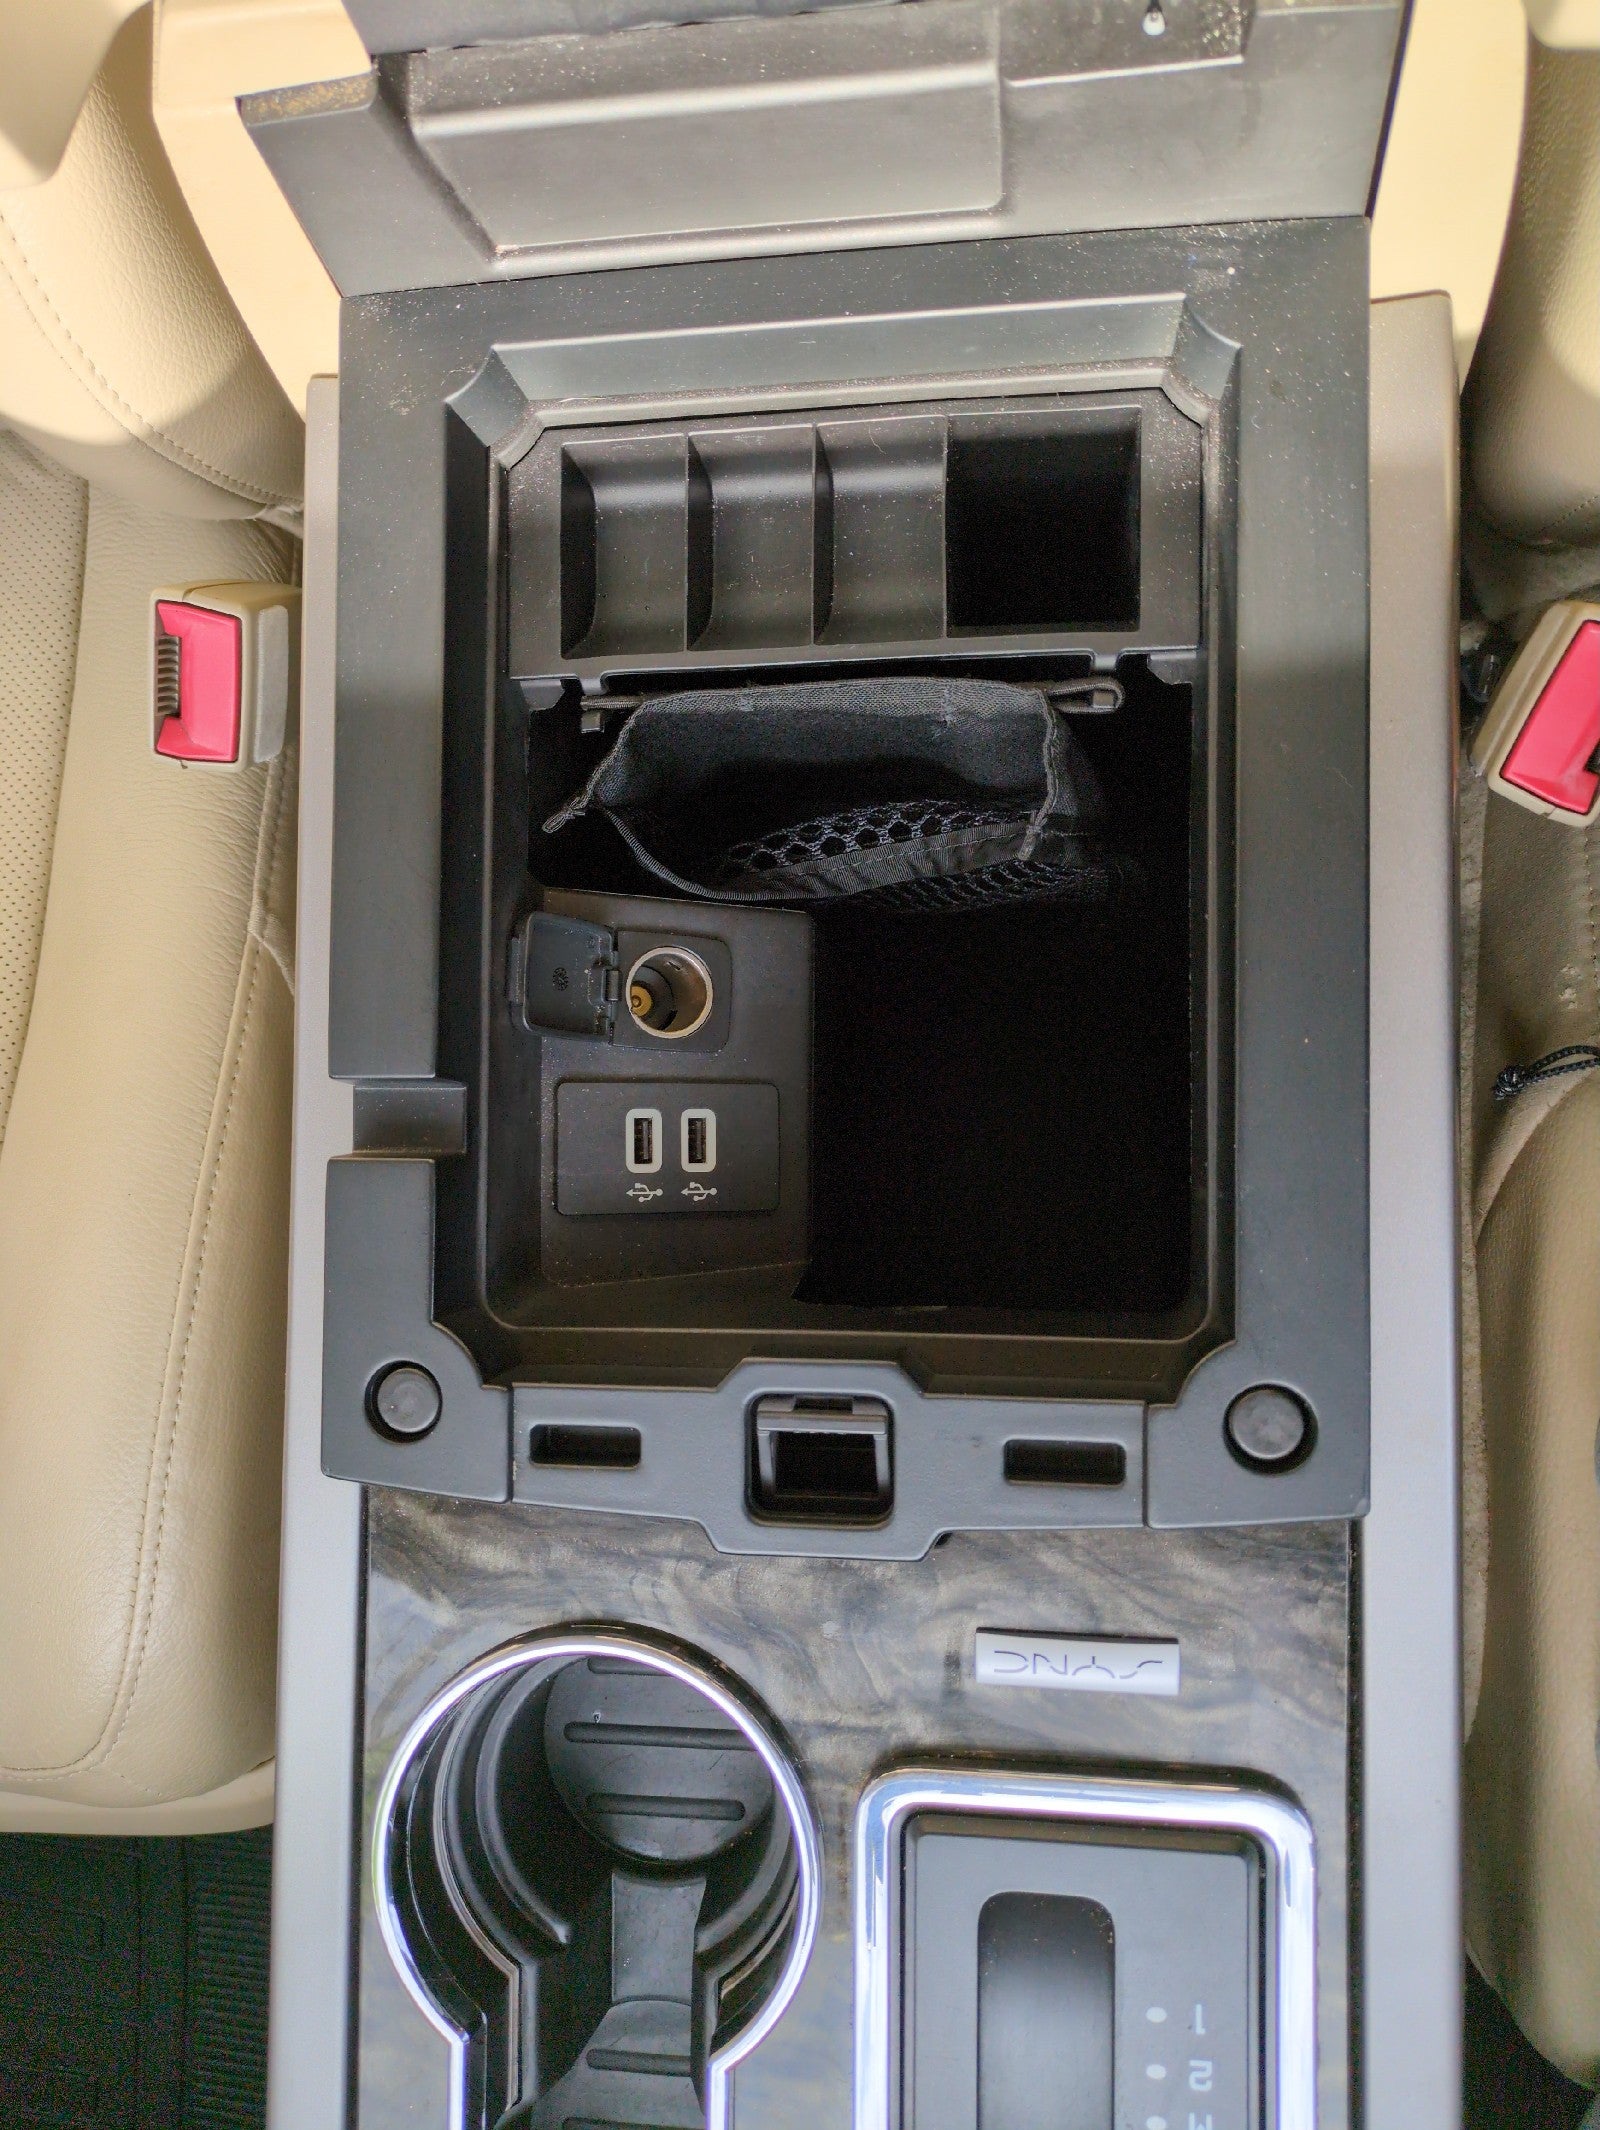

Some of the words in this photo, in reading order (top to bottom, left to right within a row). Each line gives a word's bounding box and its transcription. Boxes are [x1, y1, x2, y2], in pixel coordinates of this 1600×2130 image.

[993, 1650, 1163, 1680] SYNC
[1195, 2003, 1206, 2035] 1
[1189, 2059, 1213, 2091] 2
